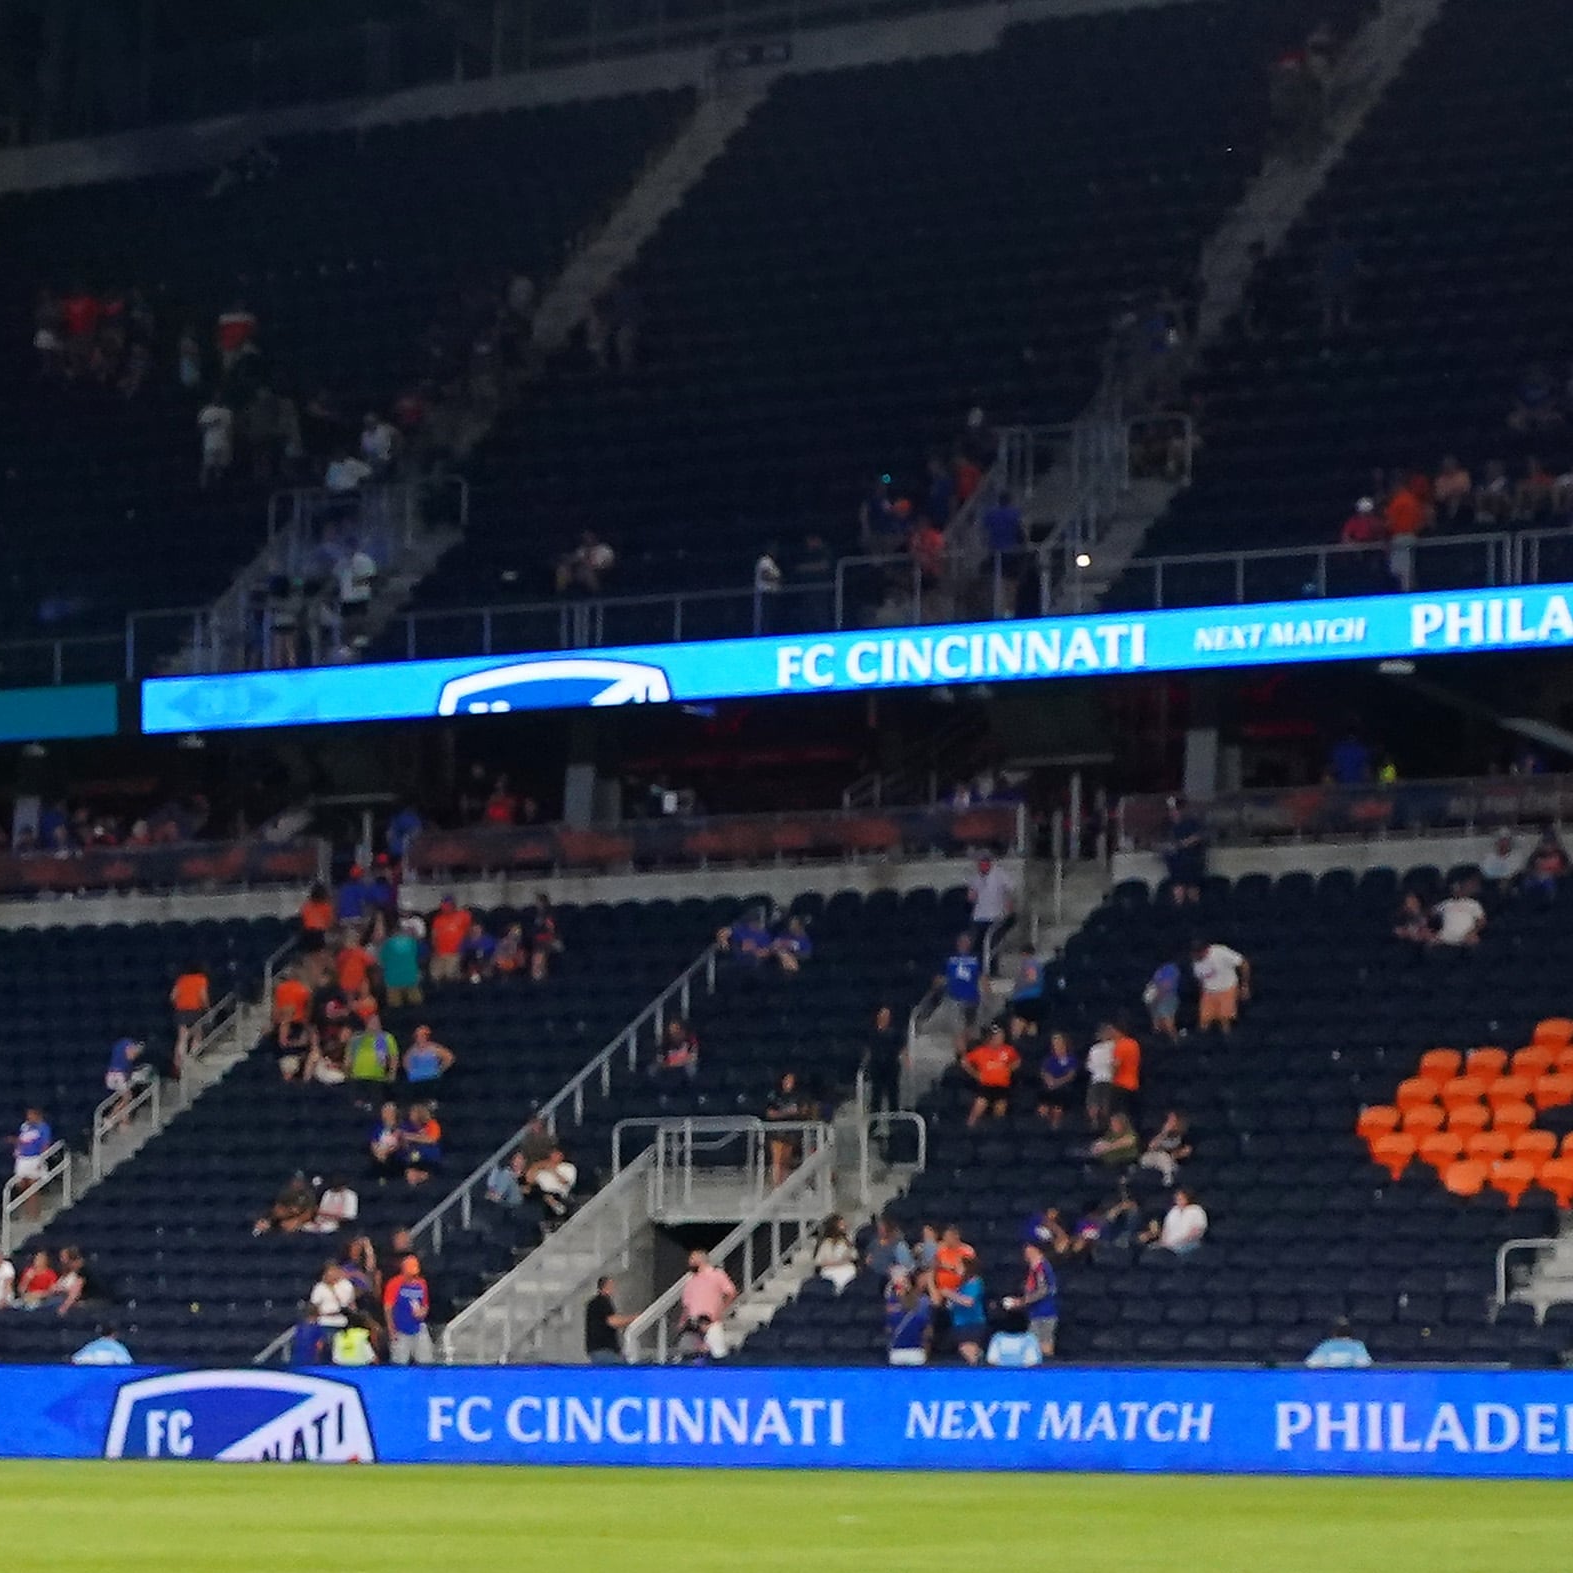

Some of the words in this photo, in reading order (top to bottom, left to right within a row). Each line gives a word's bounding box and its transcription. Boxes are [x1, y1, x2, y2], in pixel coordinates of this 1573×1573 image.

[1194, 623, 1264, 651] NEXT
[1267, 617, 1366, 646] MATCH
[1410, 595, 1573, 647] PHILA
[776, 643, 834, 687] FC
[846, 623, 1145, 684] CINCINNATI
[146, 1408, 194, 1457] FC
[427, 1396, 492, 1443] FC
[505, 1397, 844, 1446] CINCINNATI
[905, 1400, 1032, 1440] NEXT
[1037, 1400, 1214, 1442] MATCH
[1276, 1401, 1573, 1455] PHILADE
